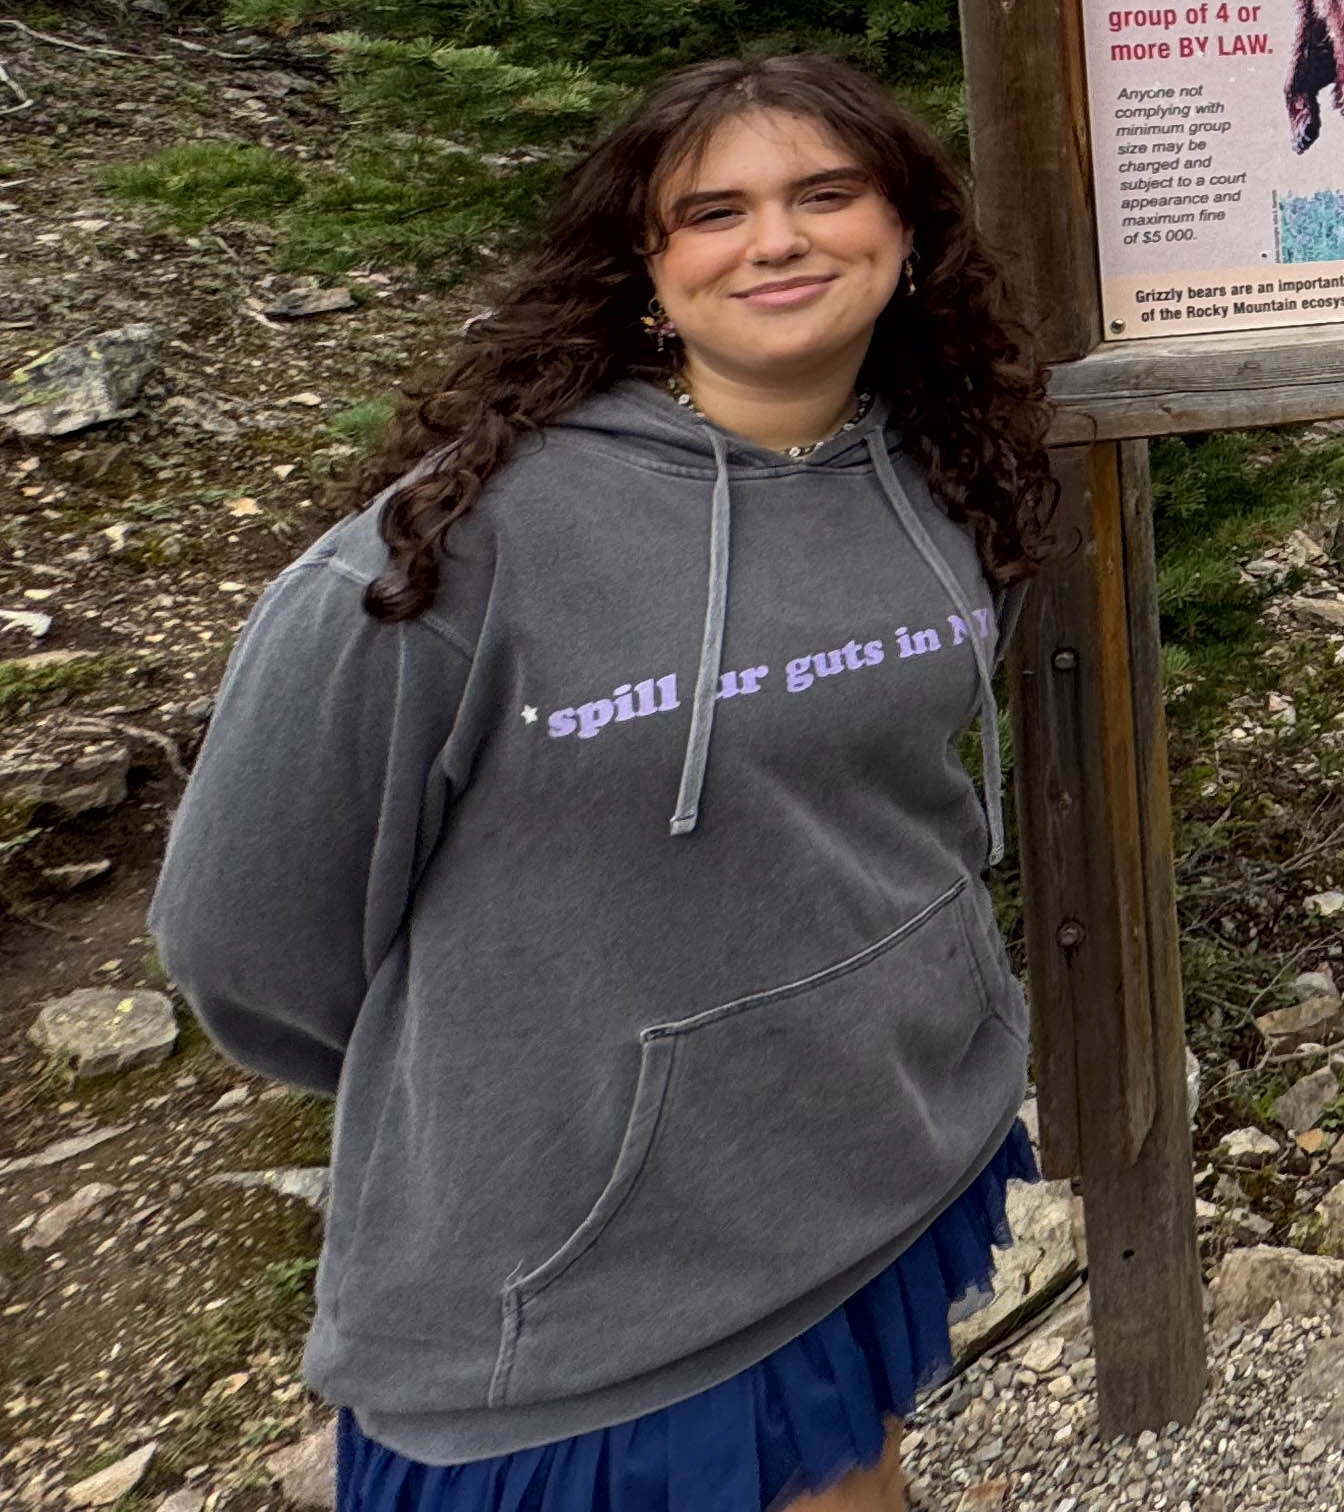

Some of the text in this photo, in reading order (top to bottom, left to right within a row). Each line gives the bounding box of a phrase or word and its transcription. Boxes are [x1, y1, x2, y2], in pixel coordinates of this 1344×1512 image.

[1109, 3, 1261, 32] group of 4 or
[1111, 34, 1273, 61] more BY LAW.
[1118, 85, 1203, 102] Anyone not
[1115, 102, 1224, 119] complying with
[1116, 121, 1231, 136] minimum group
[1118, 140, 1207, 154] size may be
[1119, 156, 1212, 174] charged and
[1120, 172, 1247, 191] subject to a court
[1121, 190, 1242, 210] appearance and
[1122, 210, 1226, 226] maximum fine
[1124, 232, 1138, 244] of
[1142, 230, 1161, 243] $5
[1136, 290, 1182, 303] Grizzly
[1188, 286, 1226, 299] bears
[1231, 285, 1252, 296] are
[1258, 282, 1274, 294] an
[1278, 276, 1344, 294] important
[1142, 309, 1154, 322] of
[1160, 307, 1182, 320] the
[1187, 305, 1228, 319] Rocky
[1234, 299, 1297, 314] Mountain
[548, 674, 680, 739] spill
[785, 638, 885, 692] guts
[895, 627, 941, 658] in
